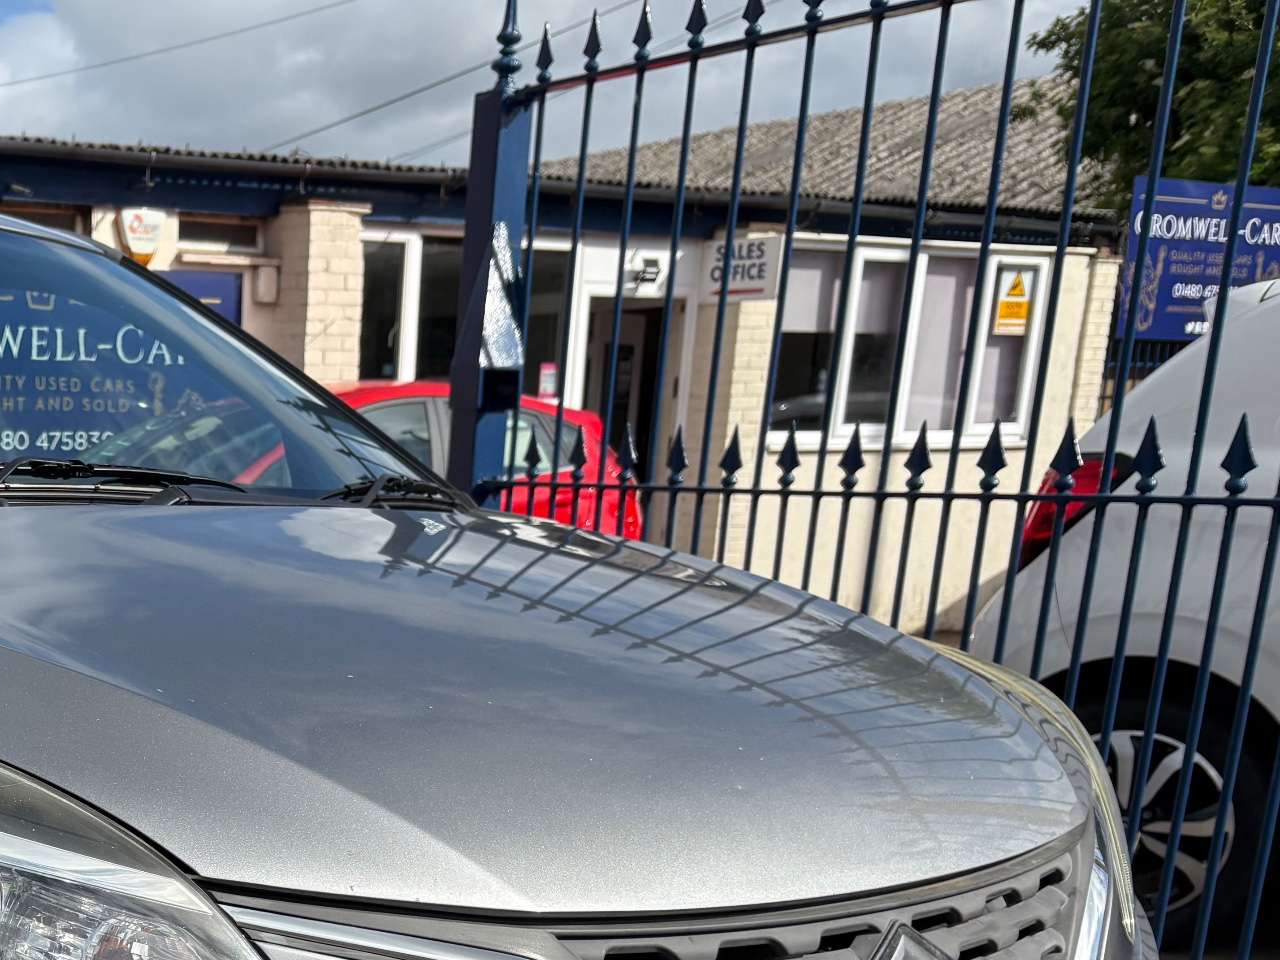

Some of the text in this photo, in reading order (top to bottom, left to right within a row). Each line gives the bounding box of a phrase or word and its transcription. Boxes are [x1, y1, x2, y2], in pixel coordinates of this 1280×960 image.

[1134, 210, 1280, 246] CROMWEL-CAR
[716, 242, 765, 263] SLES
[710, 262, 767, 282] OFICE
[34, 375, 82, 393] USED
[90, 377, 136, 394] CARS
[35, 397, 74, 413] AND
[82, 397, 130, 413] SOLD
